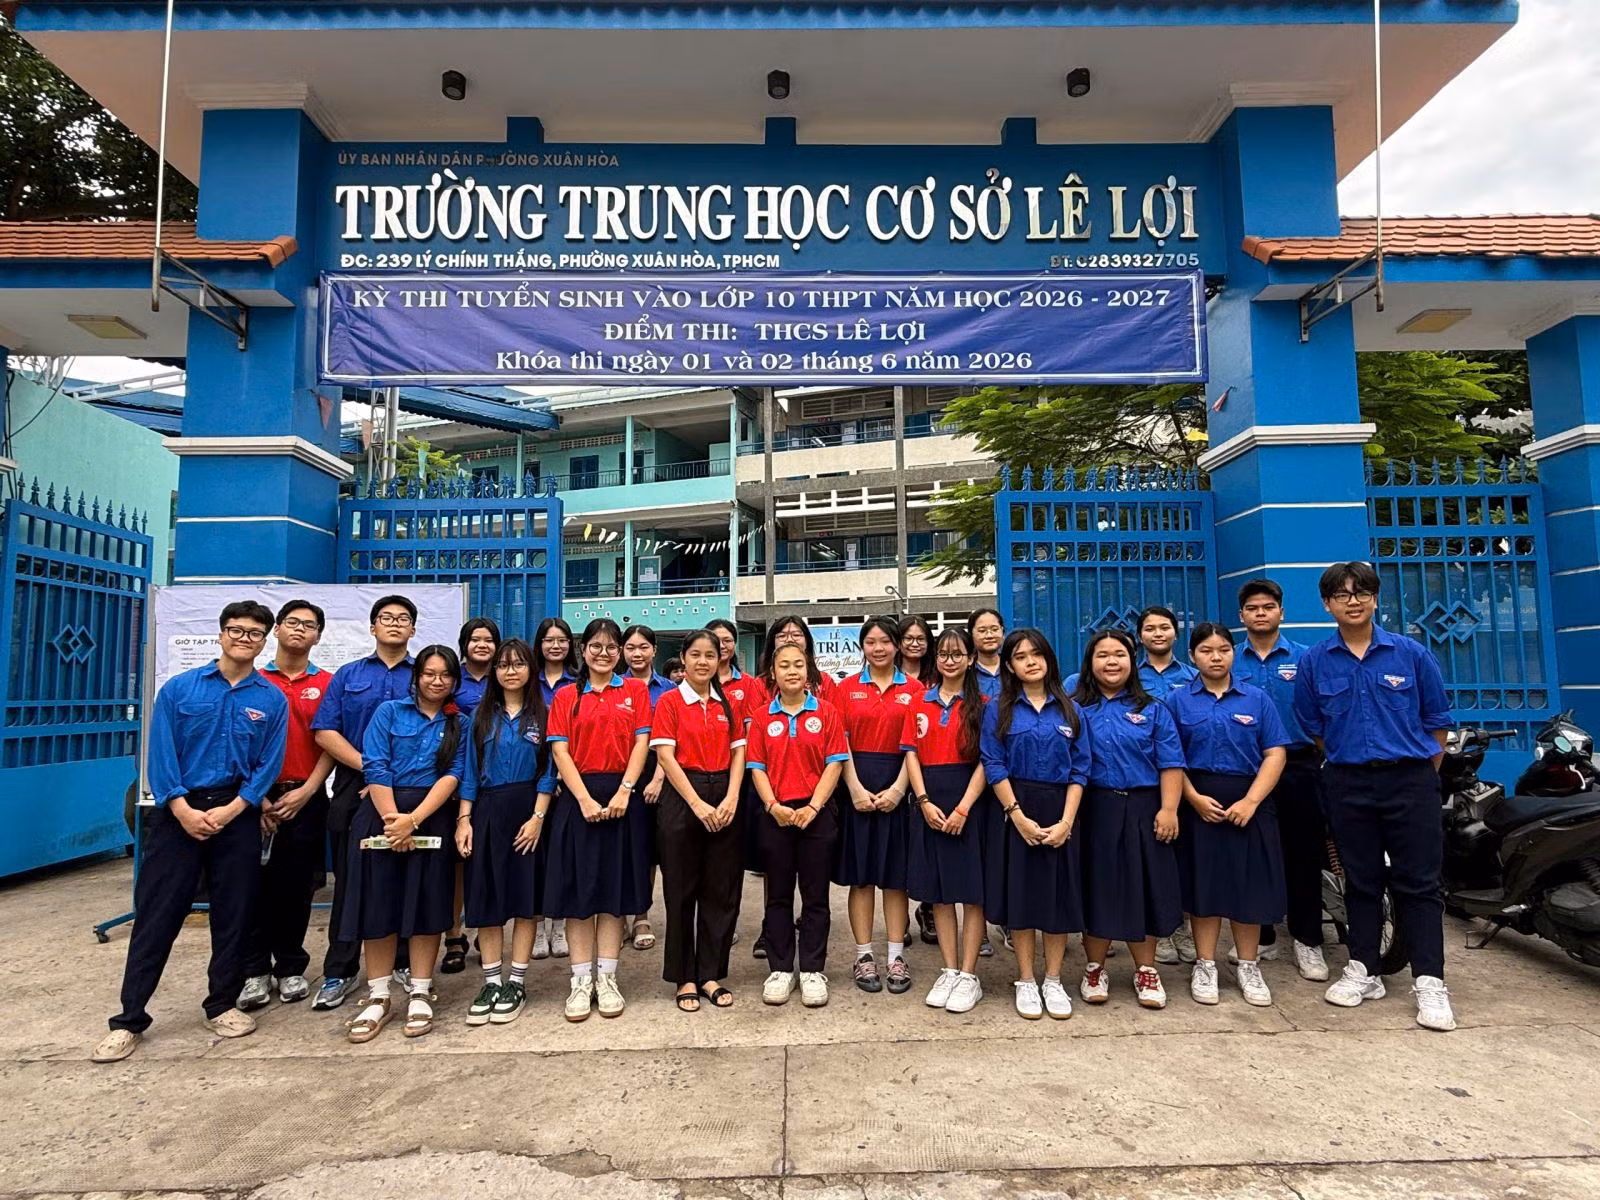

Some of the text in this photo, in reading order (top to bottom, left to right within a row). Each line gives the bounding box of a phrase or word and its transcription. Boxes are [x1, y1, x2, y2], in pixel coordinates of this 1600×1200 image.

[361, 153, 391, 165] BAN
[395, 150, 437, 165] NHÂN
[441, 150, 472, 165] DÂN
[543, 151, 583, 166] XUÂN
[588, 150, 619, 166] HÒA
[336, 167, 1199, 250] TRƯỜNG TRUNG HỌC CƠ SỞ LÊ LỢI
[340, 247, 780, 270] ĐC: 239 LÝ CHÍNH THẮNG, PHƯỜNG XUÂN HÒA, TPHCM
[1076, 253, 1200, 268] 02839327705
[353, 285, 390, 308] KỲ
[399, 290, 448, 308] THI
[456, 281, 550, 308] TUYỂN
[558, 290, 624, 308] SINH
[632, 285, 691, 308] VÀO
[700, 285, 755, 308] LỚP
[766, 290, 795, 308] 10
[803, 290, 876, 308] THPT
[884, 287, 946, 308] NĂM
[953, 290, 1011, 312] HỌC
[1019, 290, 1083, 308] 2026
[1106, 289, 1170, 307] 2027
[604, 313, 926, 345] ĐIỂM THI: THCS LÊ LỢI
[496, 350, 1032, 373] Khóa thi ngày 01 và 02 tháng 6 năm 2026
[816, 641, 839, 653] TRI
